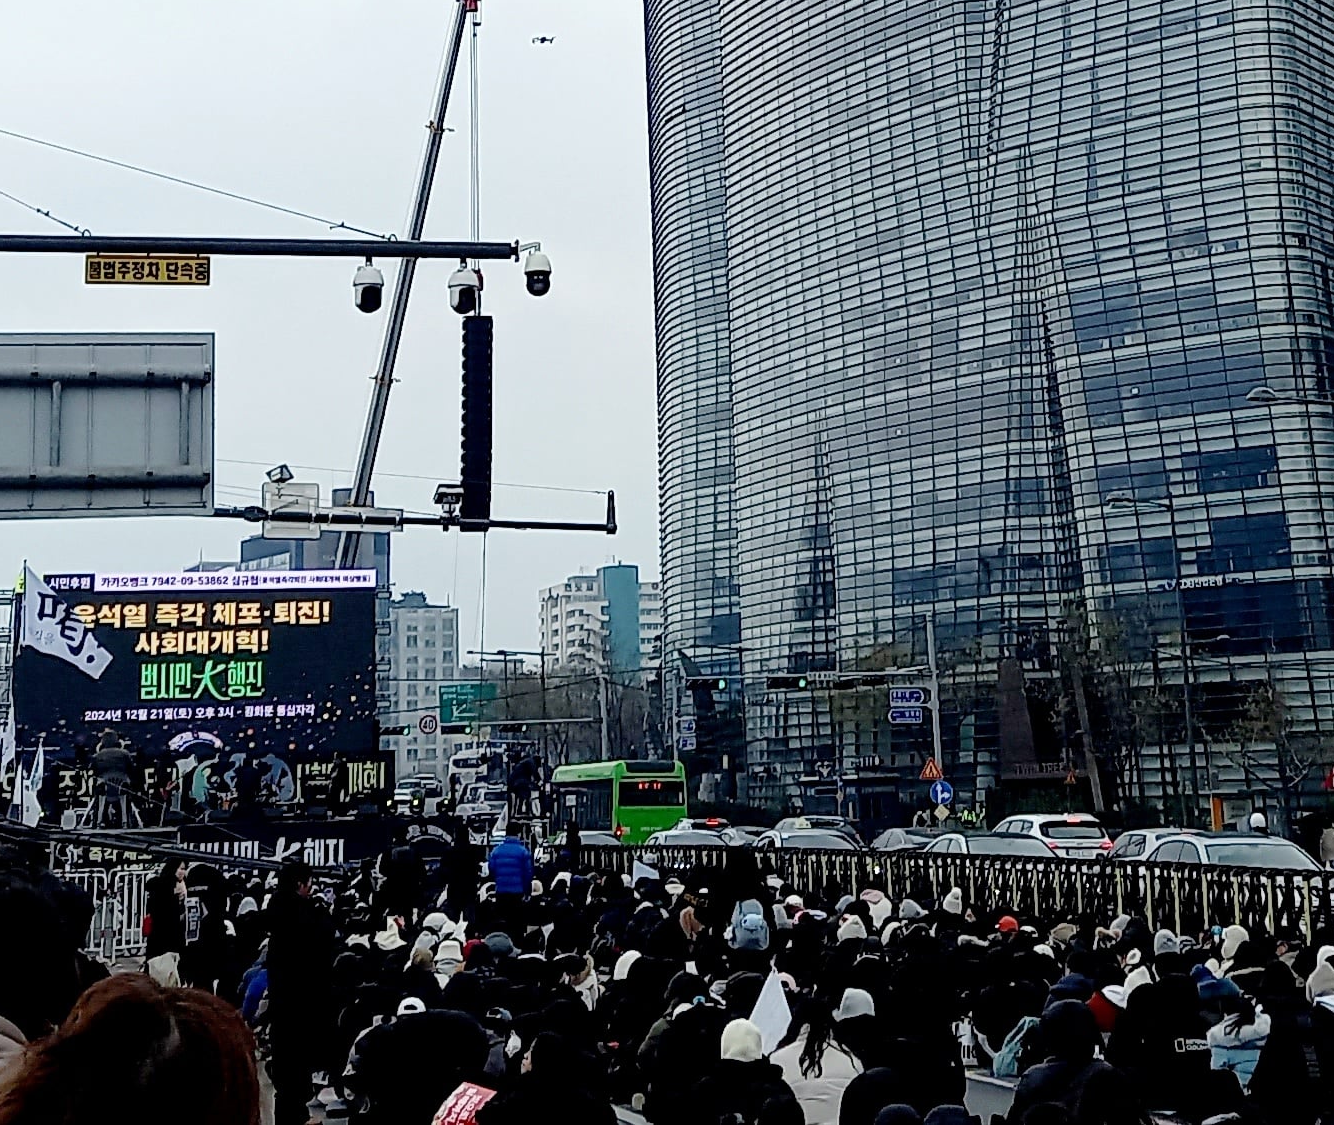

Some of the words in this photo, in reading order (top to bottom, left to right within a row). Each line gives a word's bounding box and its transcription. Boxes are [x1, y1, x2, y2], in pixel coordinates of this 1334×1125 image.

[89, 260, 160, 280] 불법주정차
[165, 261, 208, 281] 단속중
[50, 577, 91, 590] 시민후원
[71, 602, 148, 628] 윤석열
[155, 602, 205, 627] 즉각
[135, 630, 269, 656] 사회대개혁!
[84, 709, 122, 722] 2024년
[125, 708, 148, 721] 12월
[195, 707, 215, 719] 오후
[218, 707, 235, 718] 3시
[422, 719, 434, 730] 40
